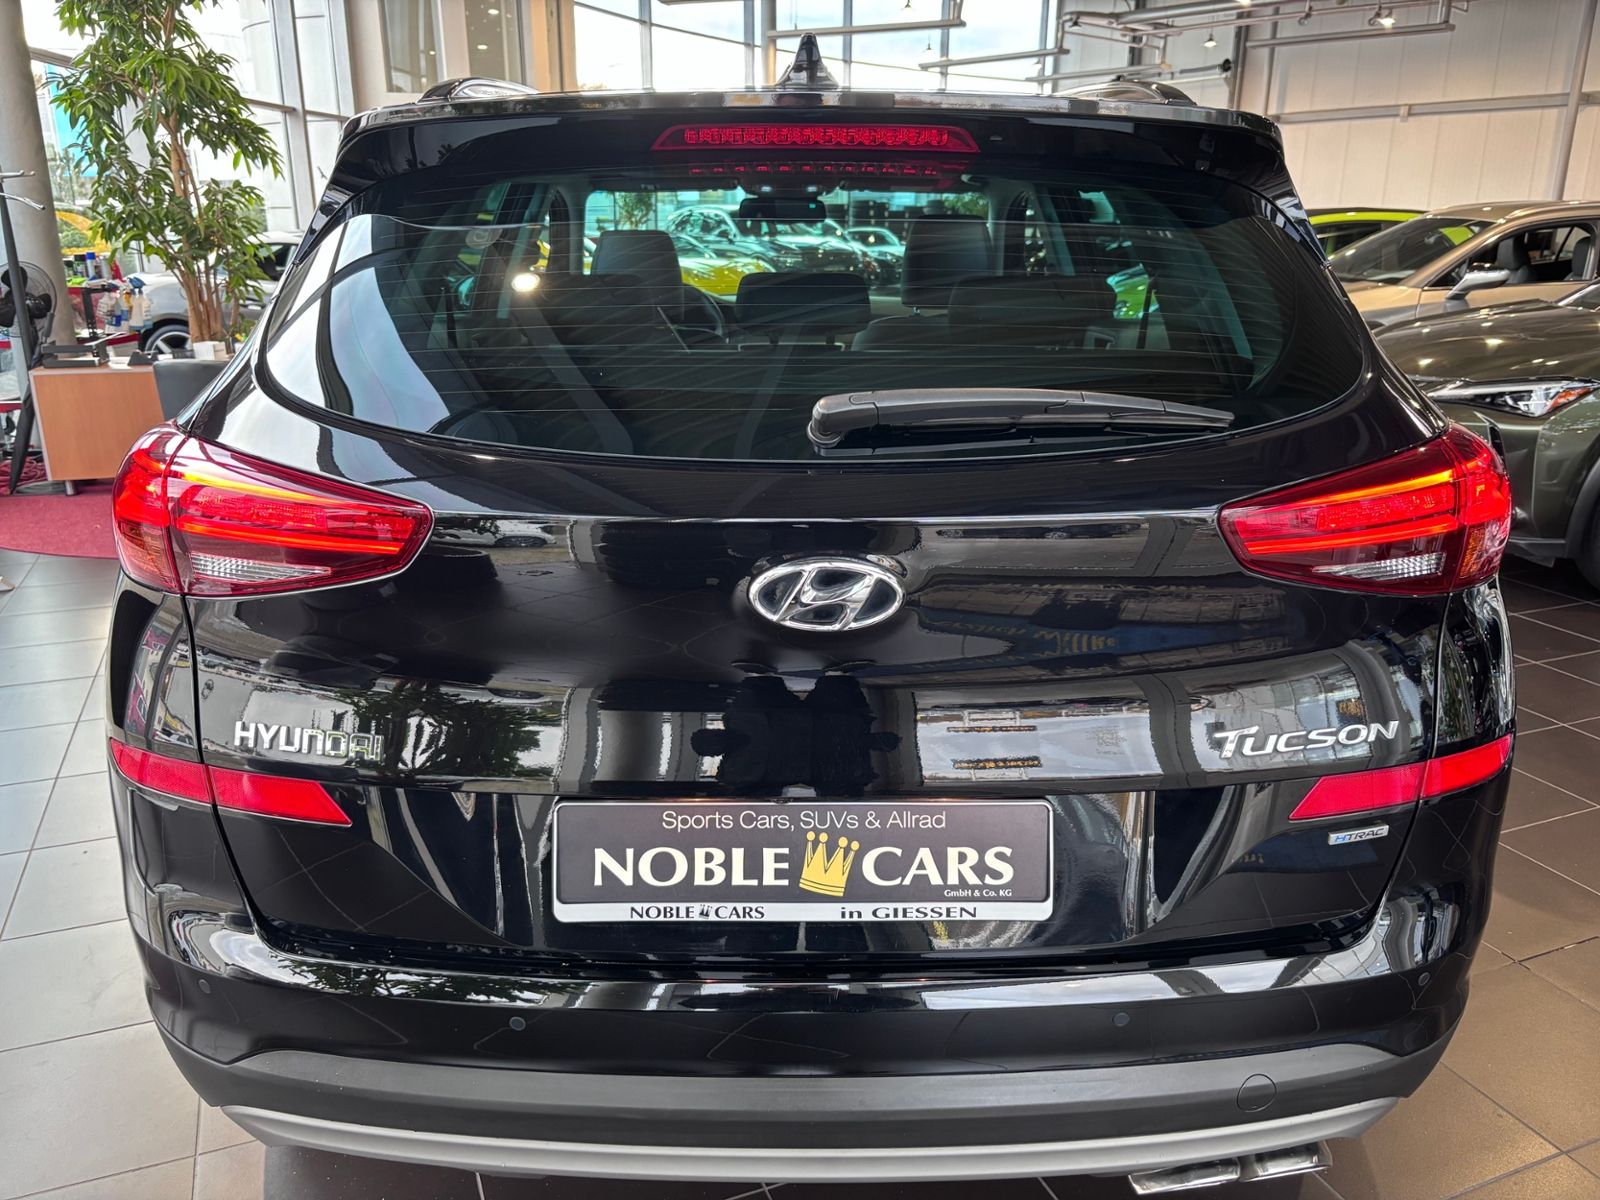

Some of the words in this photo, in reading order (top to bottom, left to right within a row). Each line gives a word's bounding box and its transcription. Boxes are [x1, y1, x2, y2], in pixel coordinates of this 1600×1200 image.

[234, 721, 384, 761] HYUNDAI
[1214, 720, 1399, 758] TUCSON
[662, 810, 733, 832] Sports
[740, 810, 795, 831] Cars,
[799, 810, 859, 829] SUVs
[865, 810, 881, 829] &
[886, 810, 946, 829] Allrad
[1334, 827, 1384, 843] HTRAC
[593, 847, 790, 887] NOBLE
[862, 846, 1015, 886] CARS
[944, 889, 972, 897] GmbH
[973, 889, 981, 897] &
[983, 889, 997, 897] Co.
[999, 889, 1012, 897] KG
[630, 906, 695, 919] NOBLE
[714, 905, 765, 919] CARS
[840, 907, 862, 919] in
[872, 907, 977, 919] GIESSEN
